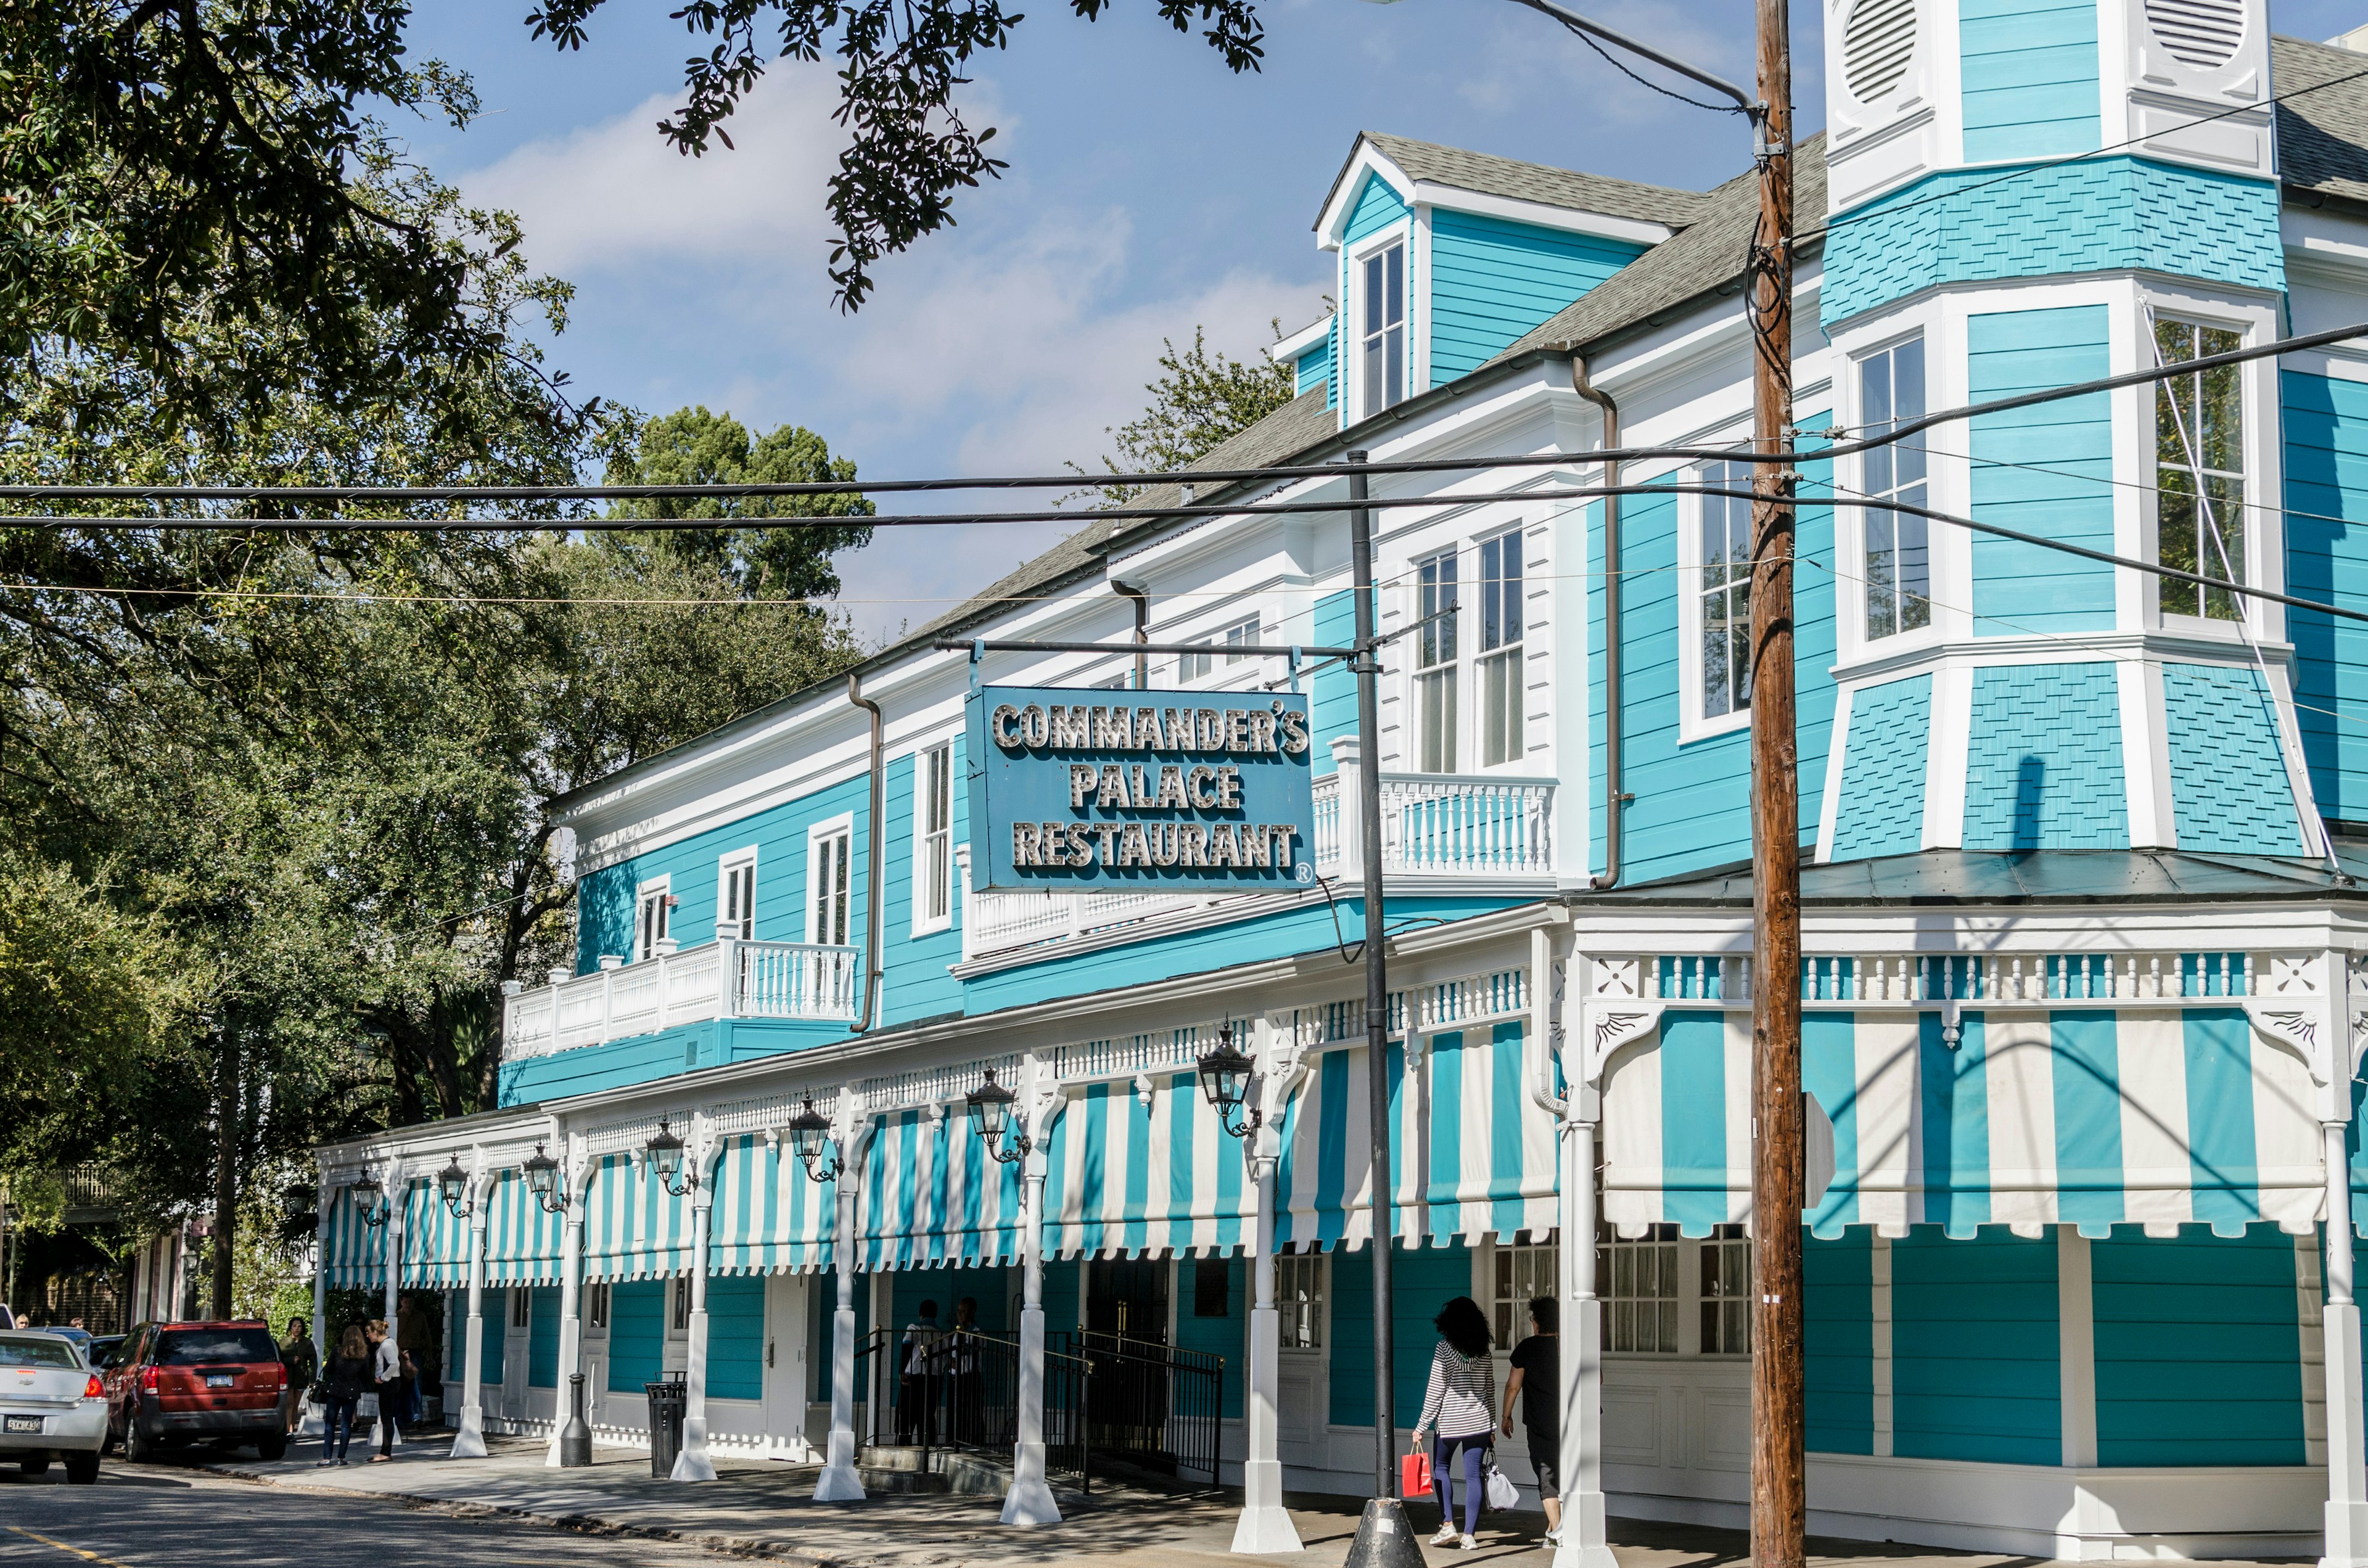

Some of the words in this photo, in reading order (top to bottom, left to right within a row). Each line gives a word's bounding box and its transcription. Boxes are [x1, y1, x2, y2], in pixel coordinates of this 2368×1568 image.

[992, 699, 1309, 753] COMMANDER'S
[1069, 764, 1240, 809] PALACE
[1013, 822, 1296, 868] RESTAURANT
